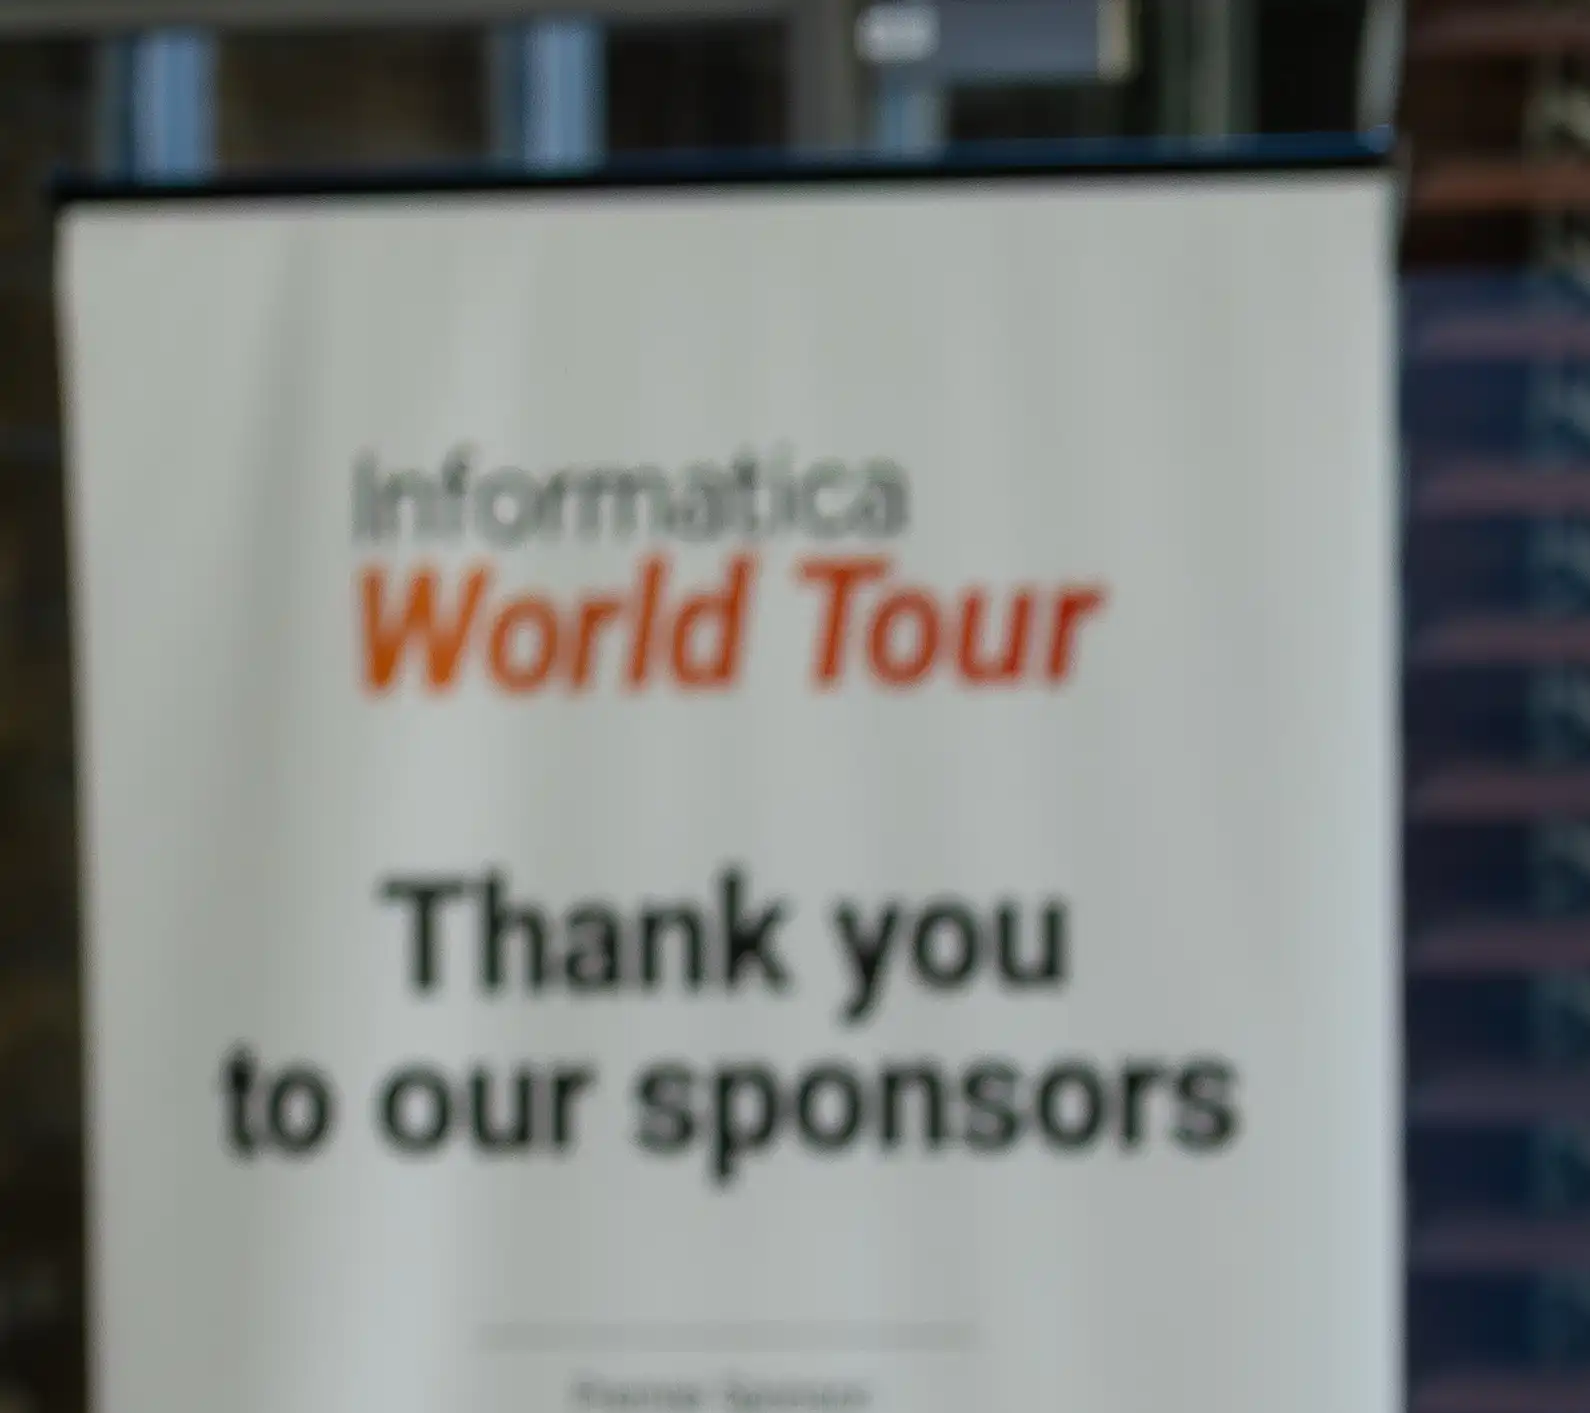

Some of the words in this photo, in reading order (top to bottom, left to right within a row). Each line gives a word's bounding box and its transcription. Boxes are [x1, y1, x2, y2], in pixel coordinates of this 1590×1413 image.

[352, 450, 910, 543] Informatica
[360, 557, 750, 692] World
[800, 555, 1106, 688] Tour
[382, 868, 790, 996] Thank
[834, 900, 1071, 1022] you
[222, 1046, 335, 1158] to
[378, 1062, 592, 1156] our
[635, 1056, 1240, 1186] sponsors
